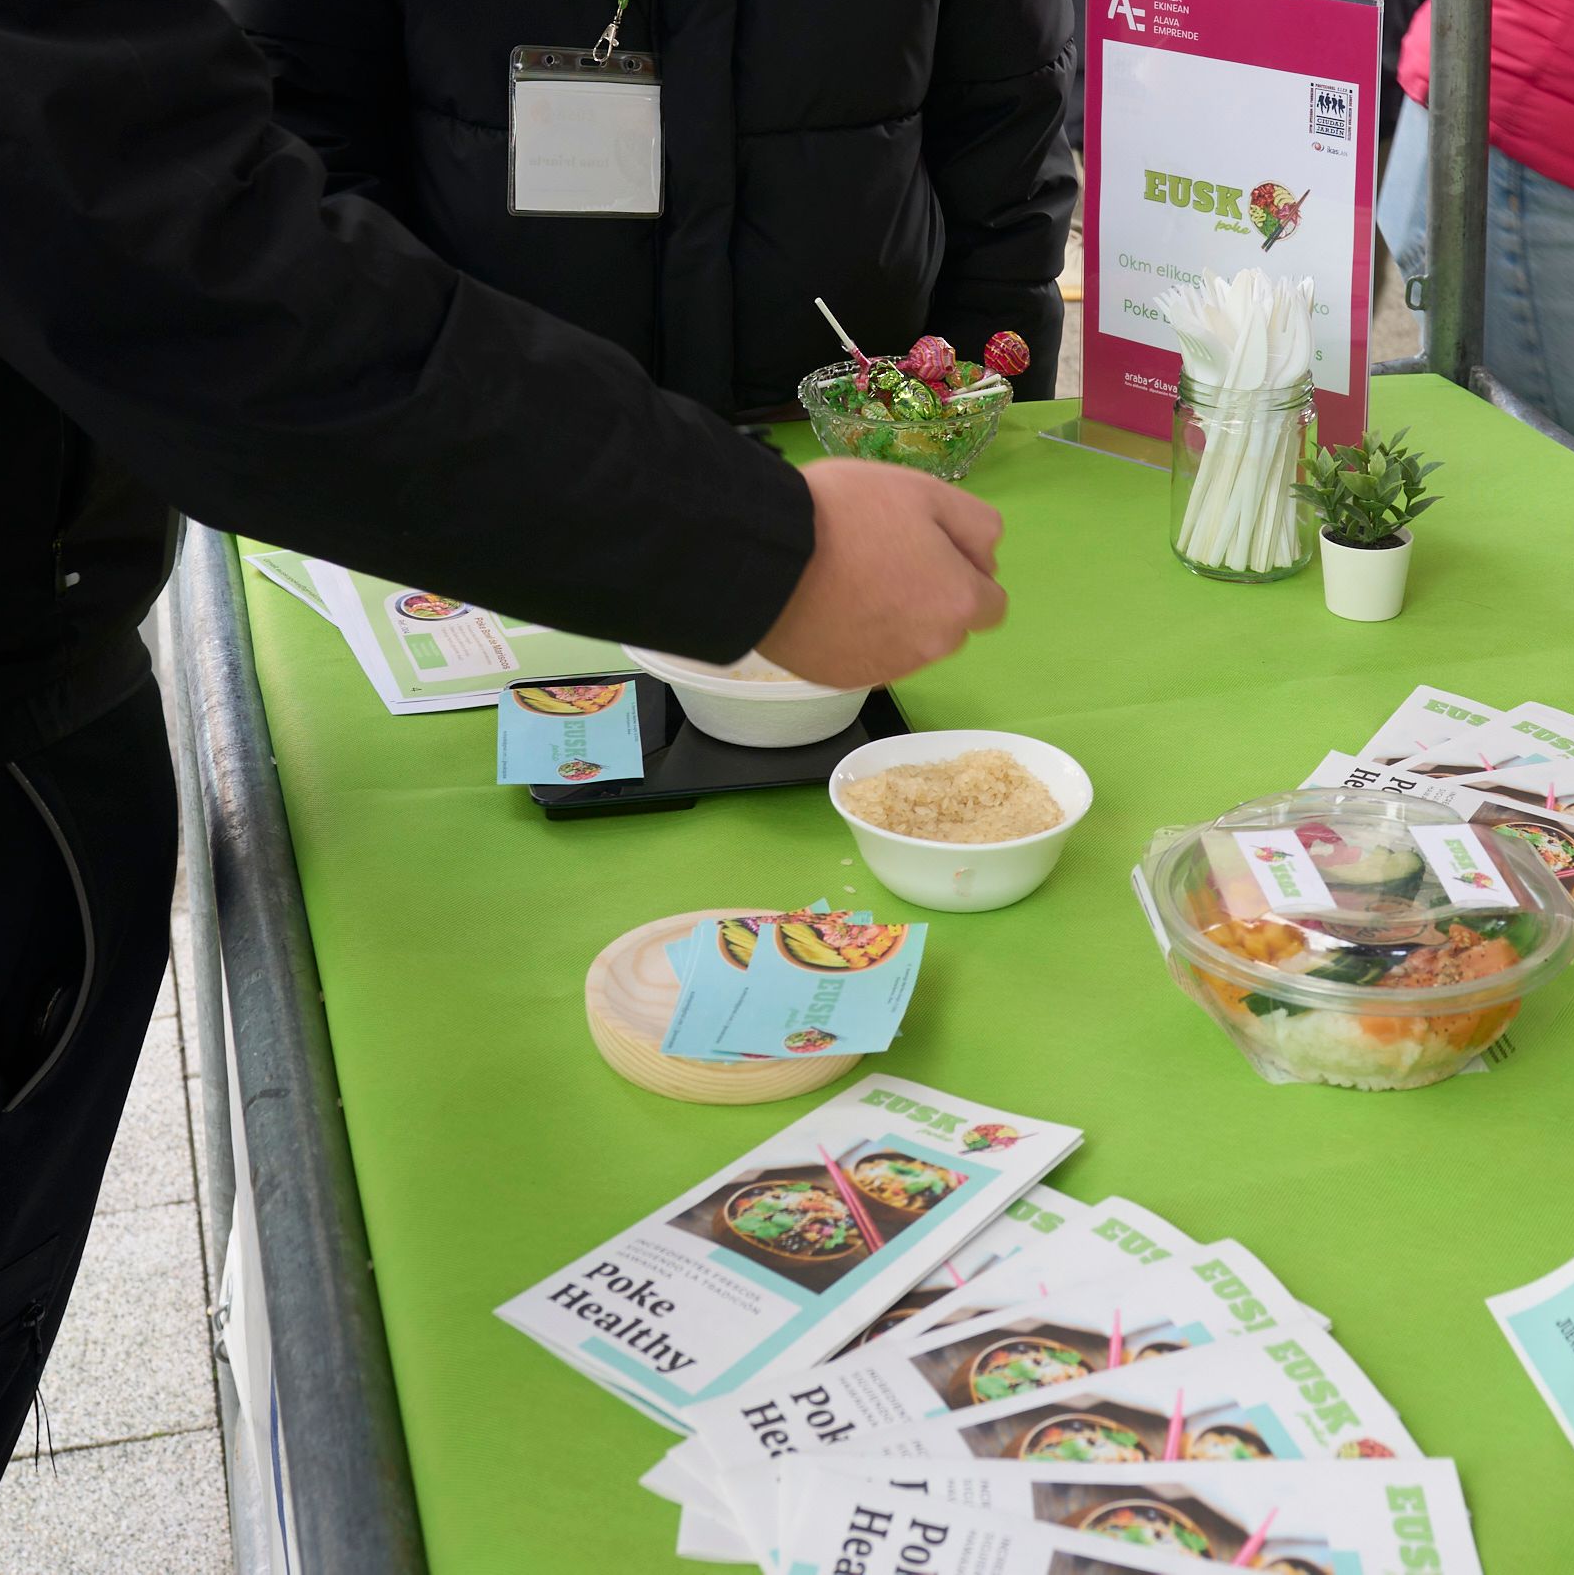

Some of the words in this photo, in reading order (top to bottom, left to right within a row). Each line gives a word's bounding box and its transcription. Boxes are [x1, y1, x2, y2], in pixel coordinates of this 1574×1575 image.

[1153, 16, 1180, 27] ALAVA
[1154, 1, 1190, 14] EKINEAN
[1153, 26, 1199, 41] EMPRENDE
[1316, 118, 1345, 128] CIUDAD
[1144, 169, 1243, 221] EUSK
[1214, 220, 1252, 235] poke
[1123, 299, 1159, 321] Poke
[1125, 372, 1148, 385] araba
[1154, 378, 1178, 393] álava
[563, 720, 588, 758] EUSK
[1339, 768, 1381, 790] He
[803, 978, 845, 1029] EUSK
[858, 1089, 969, 1134] EUSK
[581, 1261, 676, 1318] Poke
[547, 1282, 698, 1374] Healthy
[1262, 1338, 1362, 1436] EUSK
[1385, 1484, 1442, 1575] EUS
